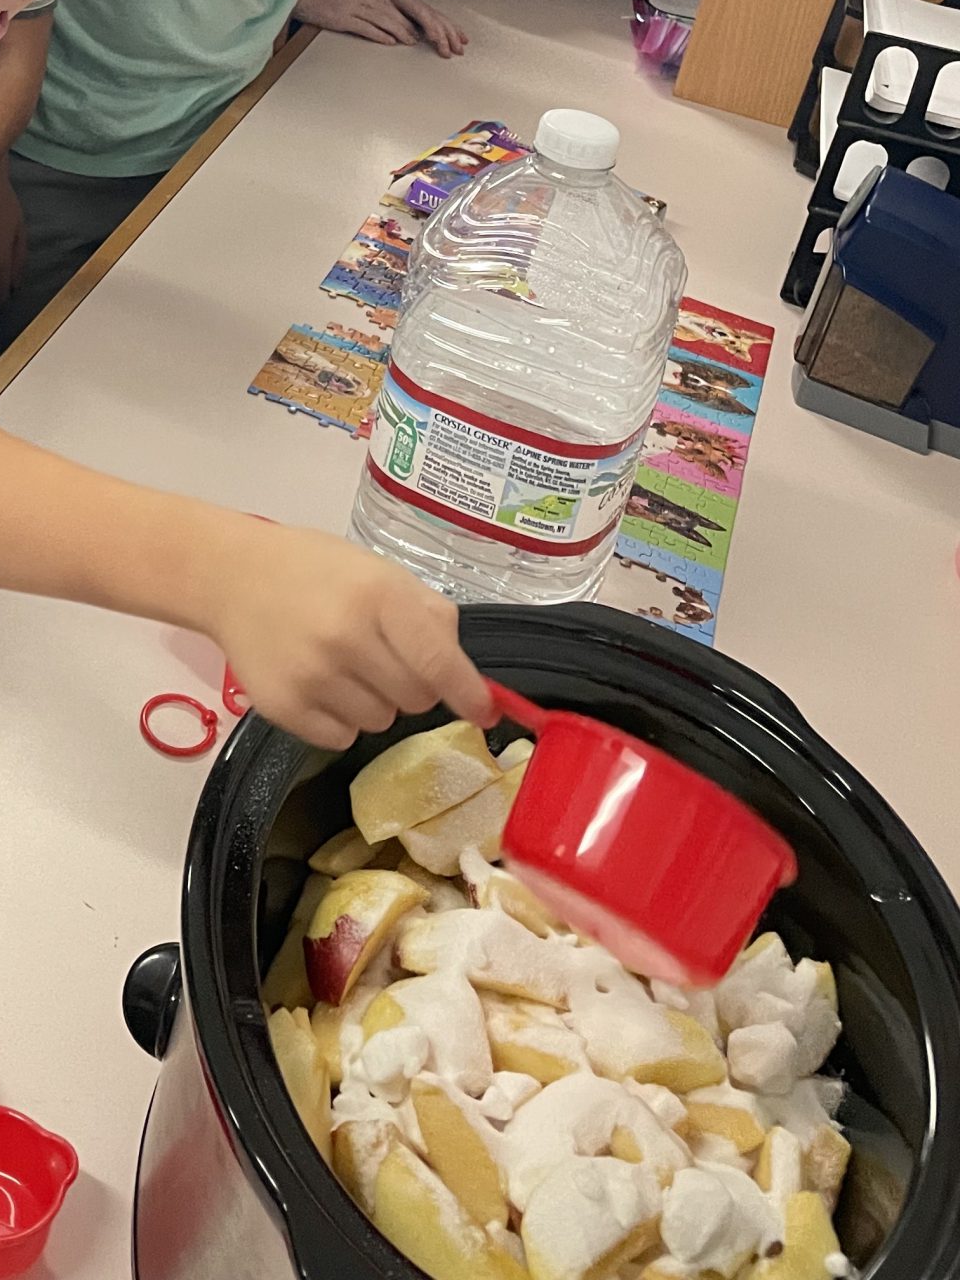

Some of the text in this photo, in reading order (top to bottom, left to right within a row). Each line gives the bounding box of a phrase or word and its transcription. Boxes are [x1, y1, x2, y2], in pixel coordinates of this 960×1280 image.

[418, 189, 443, 209] PU
[434, 412, 472, 437] CRYSTAL
[473, 430, 510, 450] GEYSER
[542, 455, 568, 469] SPRING
[519, 516, 566, 534] Johnstown, NY
